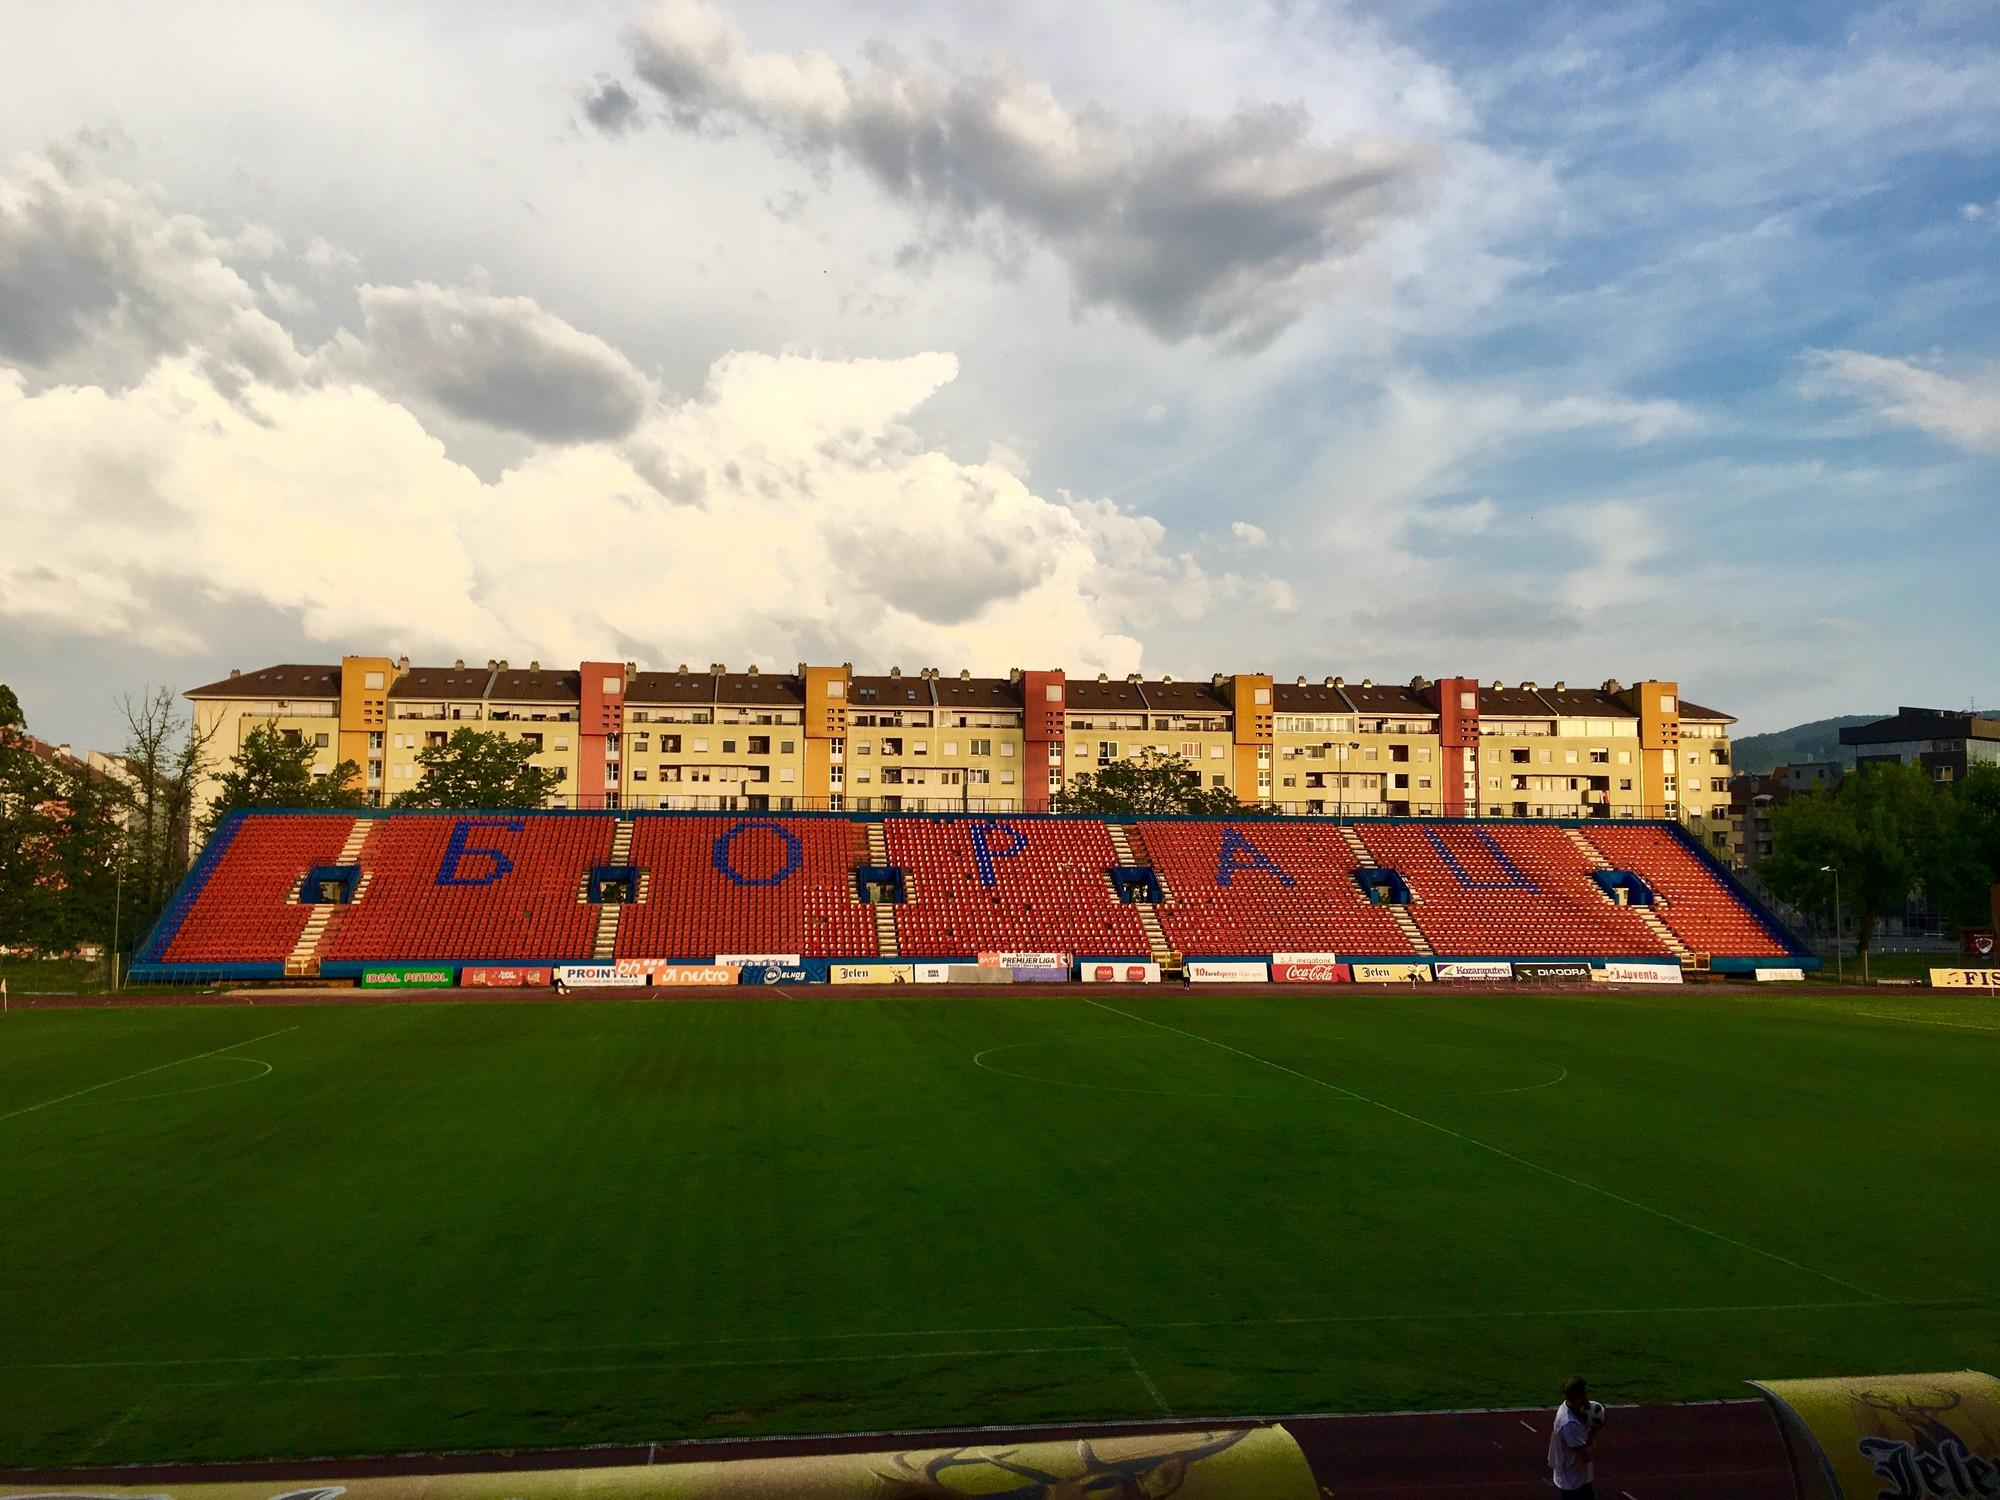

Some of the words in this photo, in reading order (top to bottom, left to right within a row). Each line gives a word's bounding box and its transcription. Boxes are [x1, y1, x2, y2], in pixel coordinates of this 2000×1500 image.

[366, 973, 400, 982] IDEAL
[404, 972, 448, 982] PETROL
[840, 968, 869, 978] Jelen
[1286, 965, 1335, 980] Coca-Cola
[1362, 967, 1390, 977] Jelen
[1537, 968, 1587, 976] DIADORA
[1622, 970, 1659, 979] Juventa
